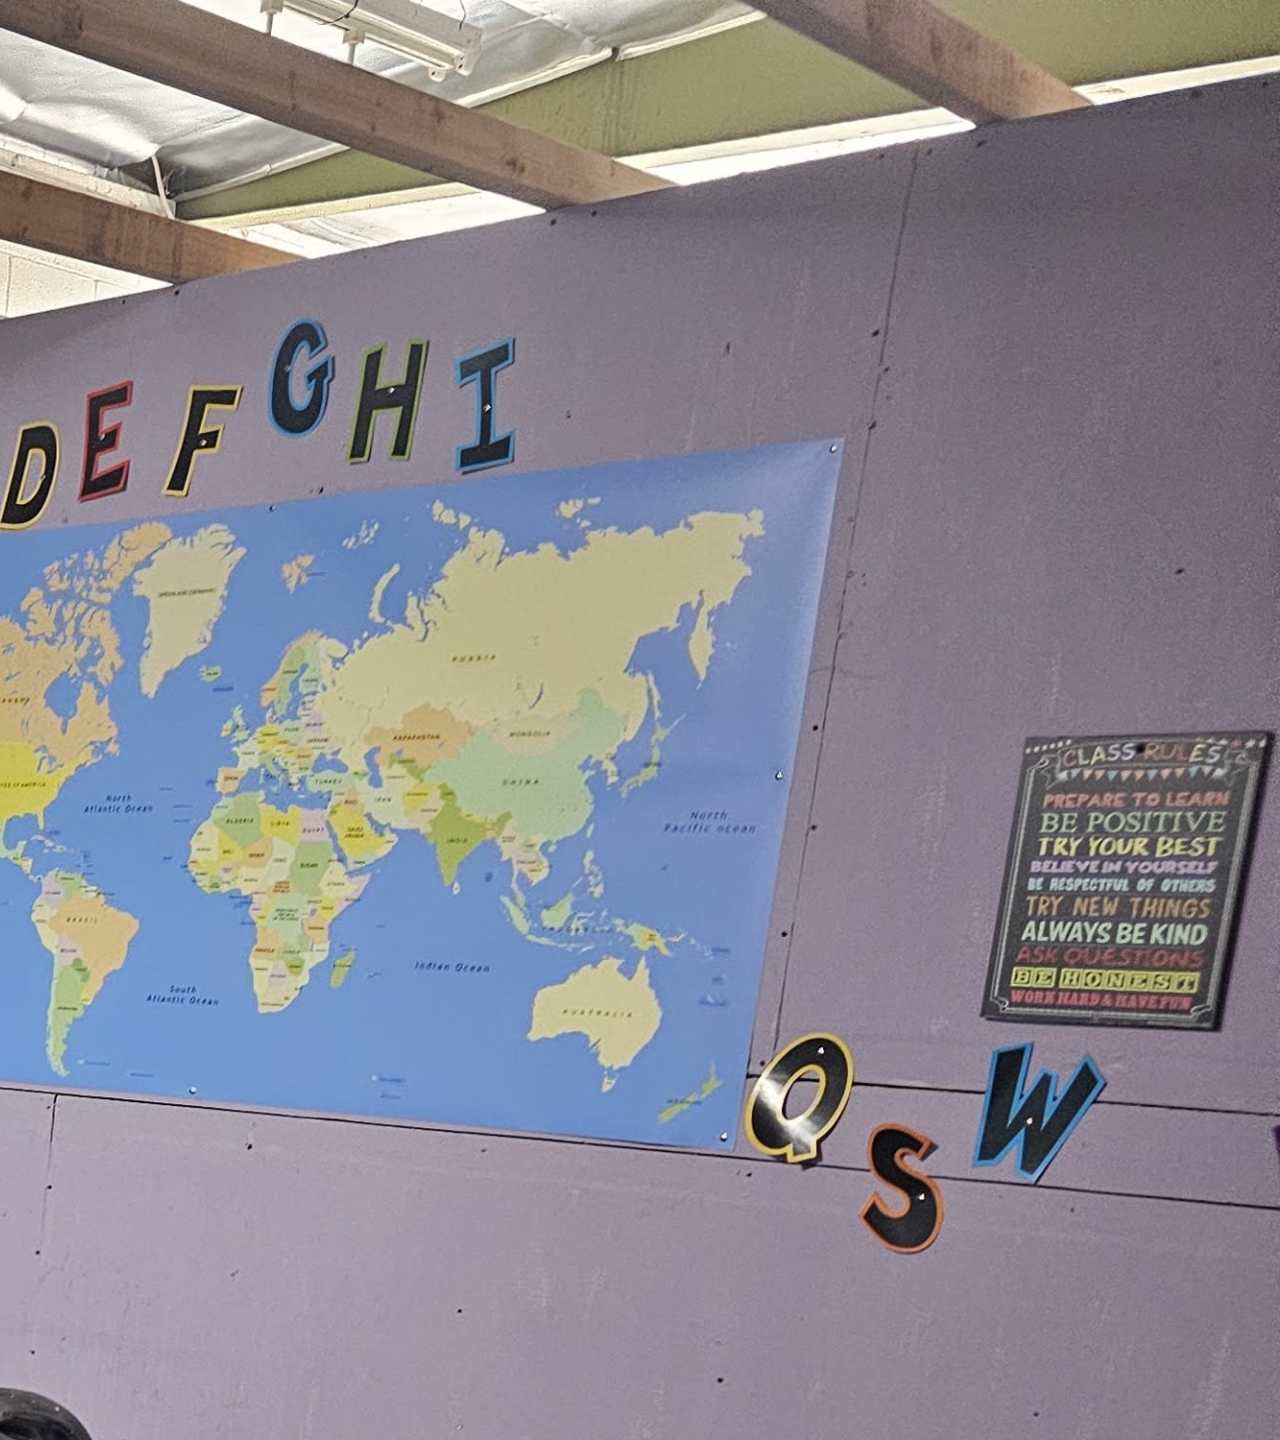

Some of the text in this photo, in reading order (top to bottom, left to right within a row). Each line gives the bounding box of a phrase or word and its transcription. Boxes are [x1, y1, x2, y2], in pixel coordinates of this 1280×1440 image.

[80, 381, 134, 502] E
[161, 384, 243, 498] F
[267, 319, 334, 438] G
[347, 338, 429, 465] H
[455, 337, 516, 474] I
[1062, 741, 1222, 767] CLASS RULES
[1042, 789, 1233, 809] PREPARE TO LEARN
[1040, 809, 1228, 834] BE POSITIVE
[1037, 836, 1226, 858] TRY YOUR BEST
[1124, 859, 1219, 874] YOURSELF
[1049, 877, 1130, 893] RESPECTFUL
[1025, 895, 1214, 920] TRY NEW THINGS
[1020, 919, 1210, 946] ALWAYS BE KIND
[1014, 945, 1206, 968] ASK QUESTIONS
[1011, 967, 1200, 993] BE HONEST
[743, 1031, 854, 1164] Q
[971, 1040, 1108, 1185] W
[857, 1122, 944, 1255] S
